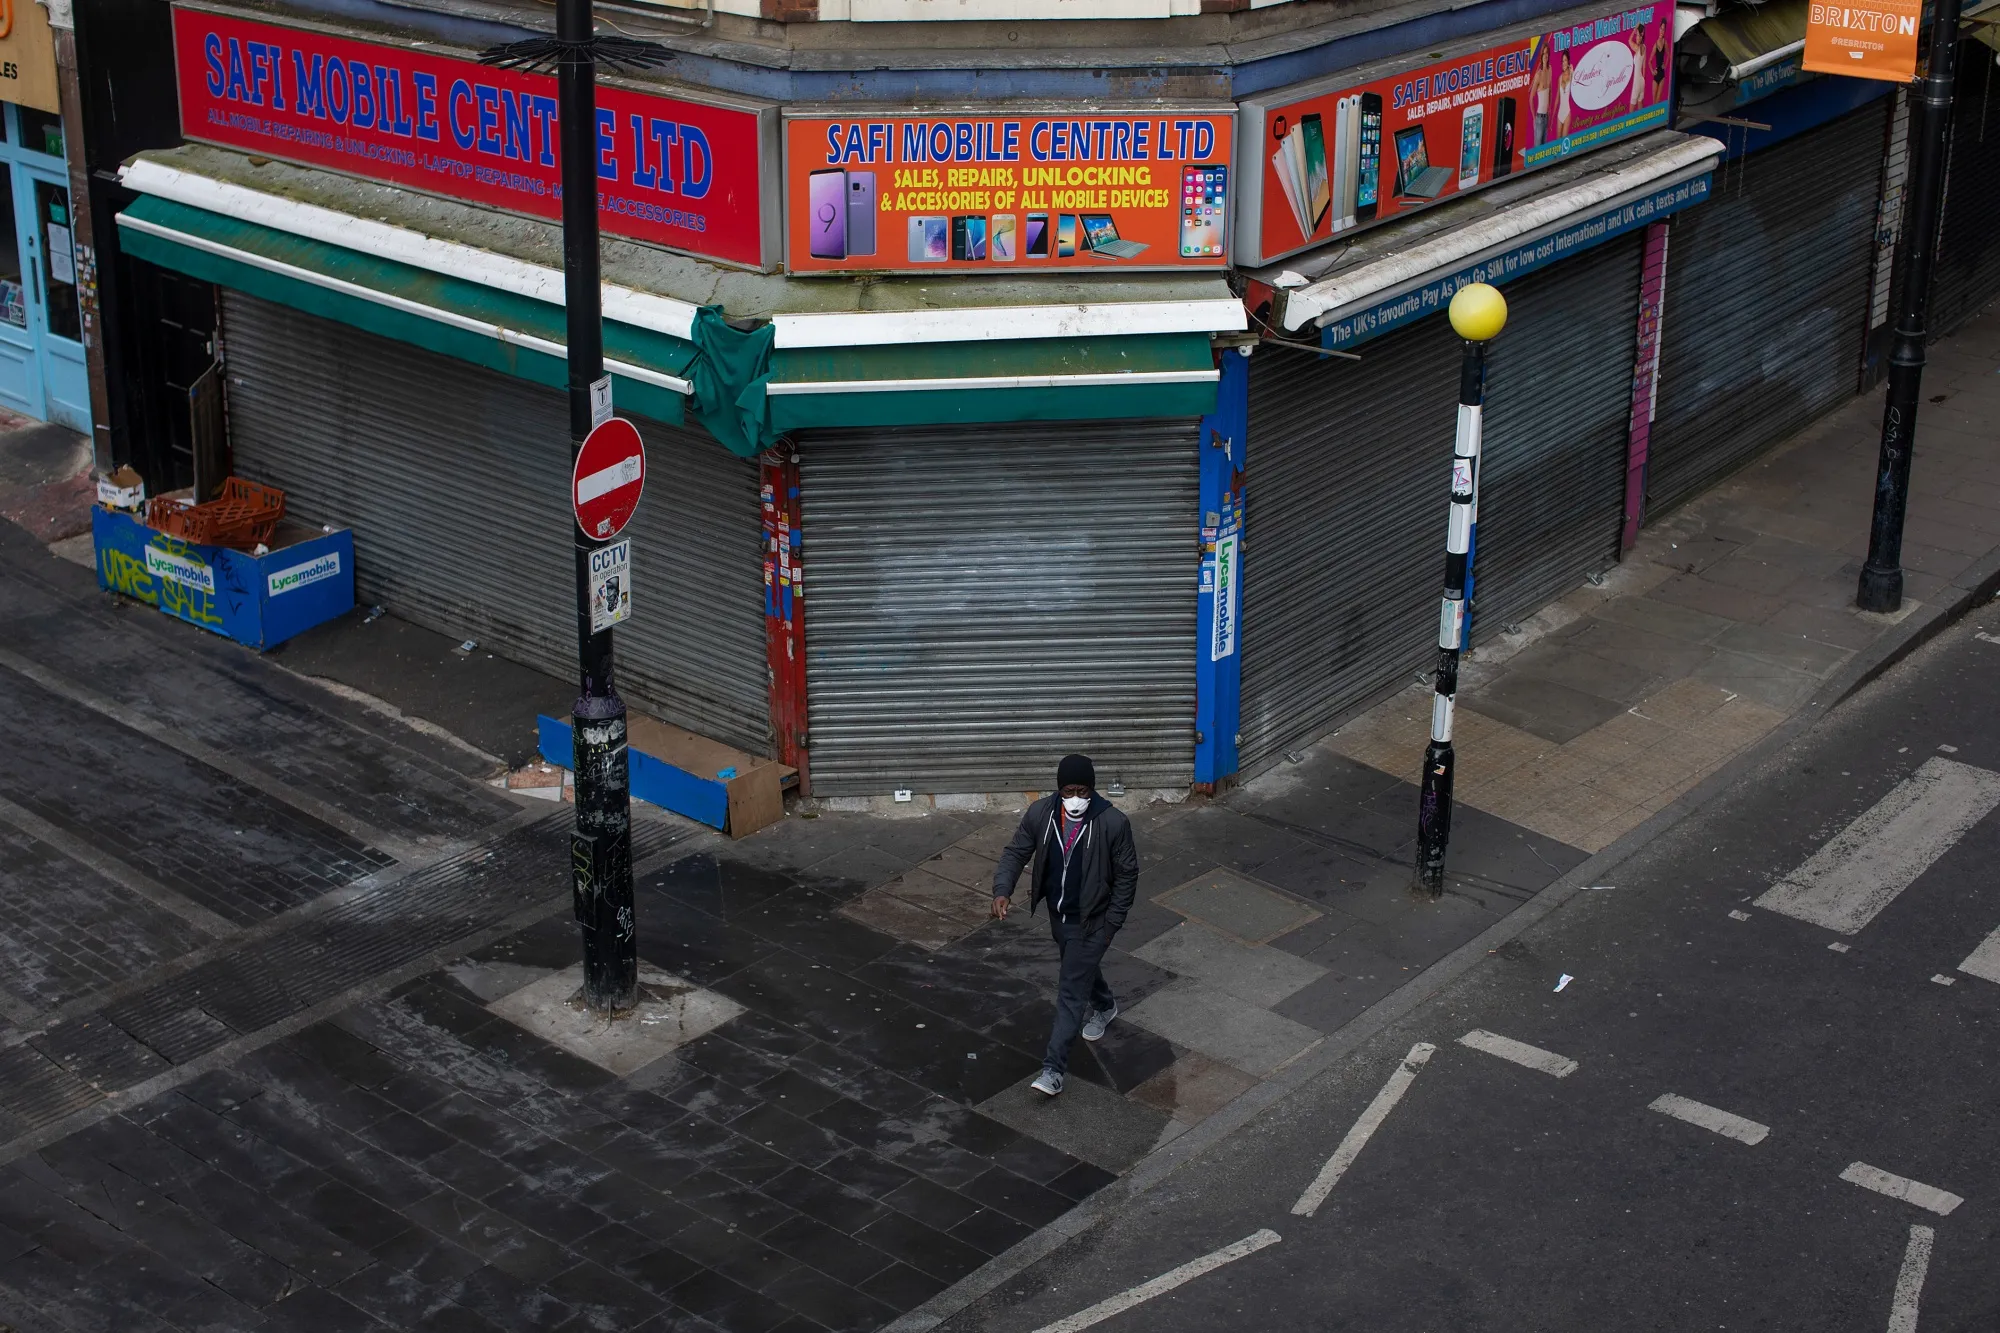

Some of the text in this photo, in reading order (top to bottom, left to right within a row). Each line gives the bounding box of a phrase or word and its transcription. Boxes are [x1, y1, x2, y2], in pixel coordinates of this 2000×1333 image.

[1554, 32, 1570, 52] The
[1572, 26, 1594, 47] Best
[1595, 15, 1621, 39] Waist
[1810, 4, 1916, 36] BRIXTON
[1831, 36, 1884, 51] #REBRIXTON
[0, 62, 18, 80] ES
[1393, 77, 1430, 110] SAFI
[1433, 57, 1493, 98] MOBILE
[1407, 104, 1426, 121] SALES,
[1426, 98, 1452, 116] REPAIRS,
[1452, 88, 1487, 107] UNLOCKING
[1488, 85, 1493, 96] &
[1493, 76, 1521, 96] ACCESSORIES
[205, 32, 713, 199] SAFI MOBILE CENTE LTD
[826, 120, 1216, 164] SAFI MOBILE CENTRE LTD
[208, 108, 228, 127] ALL
[229, 112, 271, 137] MOBILE
[272, 123, 332, 151] REPAIRING
[335, 136, 343, 151] &
[345, 138, 415, 167] UNLOCKING
[423, 155, 473, 179] LAPTOP
[475, 166, 545, 196] REPAIRING
[606, 197, 706, 233] ACCESSORIES
[894, 166, 1151, 190] SALES, REPAIRS, UNLOCKING
[880, 189, 1169, 212] & ACCESSORIES OF ALL MOBILE DEVICES
[817, 203, 836, 233] 9
[1332, 324, 1350, 344] The
[1353, 312, 1376, 336] UK's
[1377, 297, 1419, 324] favourite
[1422, 288, 1439, 307] Pay
[1441, 281, 1453, 298] As
[1454, 275, 1470, 291] You
[1473, 268, 1485, 284] Go
[1488, 261, 1504, 281] SIM
[1506, 256, 1518, 272] for
[1519, 248, 1535, 267] low
[1536, 241, 1554, 259] cost
[1556, 217, 1605, 252] International
[1607, 212, 1622, 231] and
[1623, 207, 1635, 224] UK
[1656, 193, 1674, 211] texts
[1675, 187, 1689, 204] and
[1691, 179, 1706, 196] data
[148, 553, 211, 586] Lycamobile
[592, 543, 627, 573] CCTV
[592, 562, 628, 583] in operation
[271, 560, 337, 590] Lycamobile
[162, 575, 223, 625] SALE
[1218, 540, 1233, 654] Lycamobile
